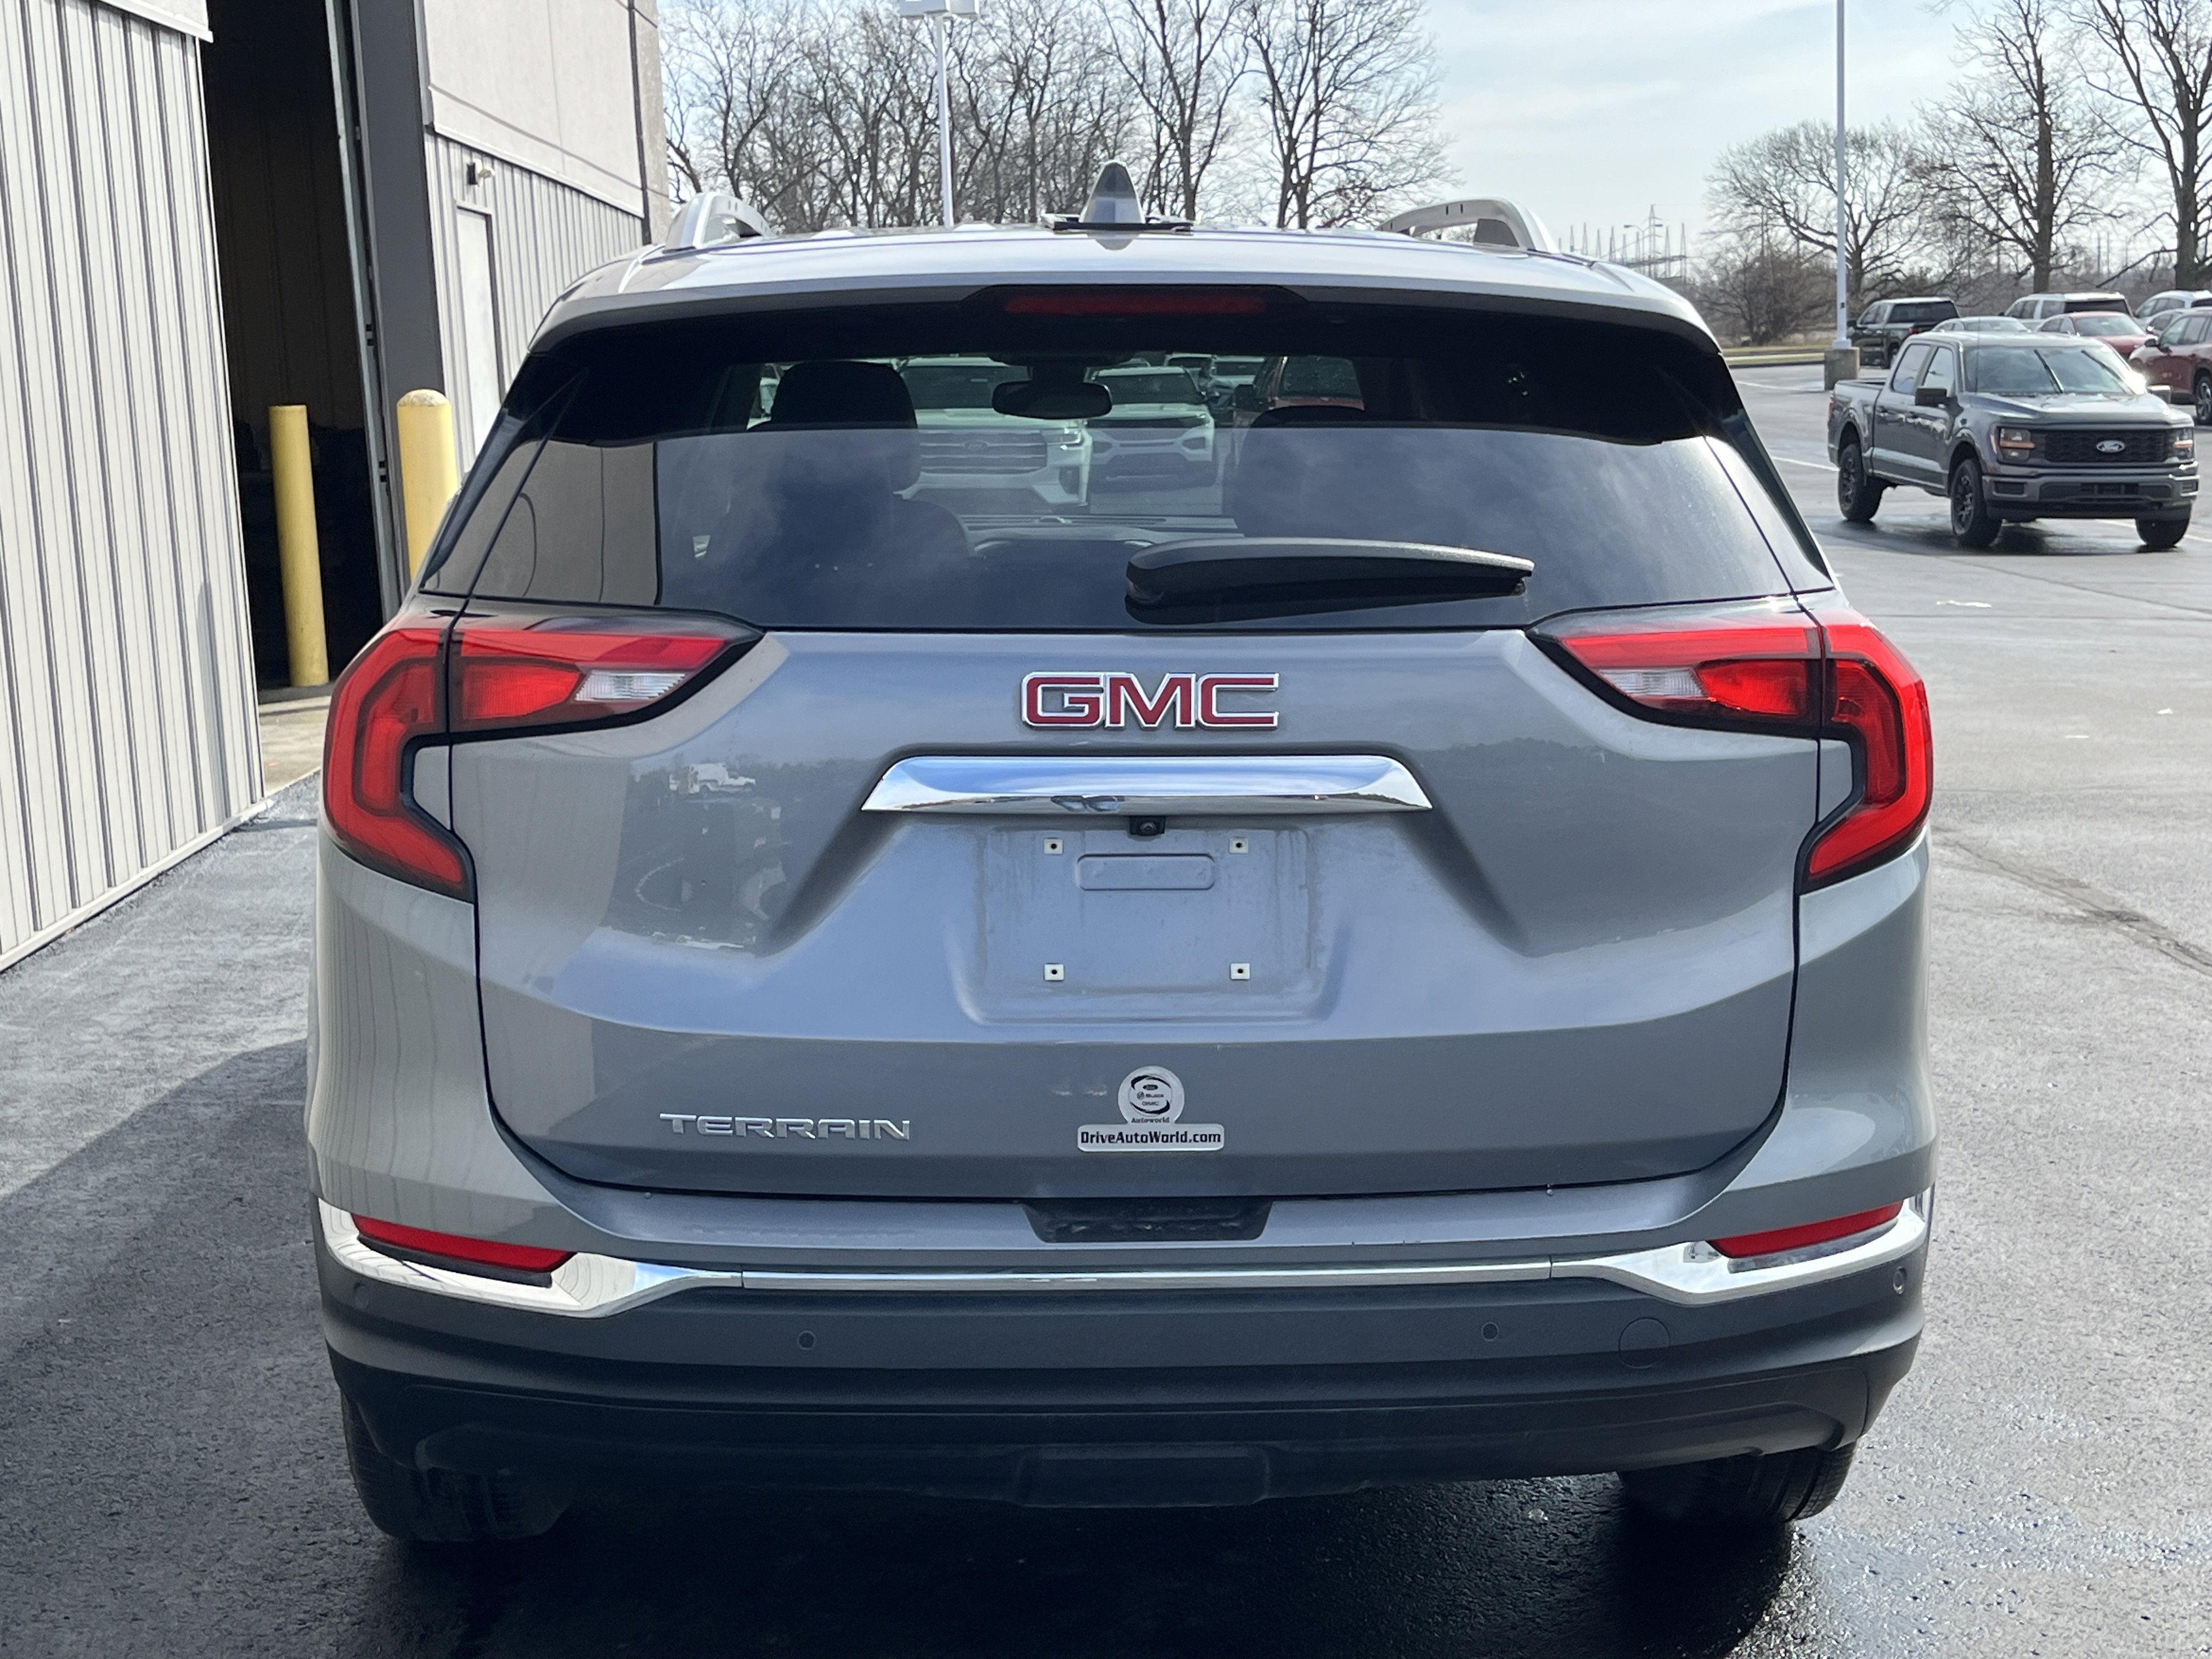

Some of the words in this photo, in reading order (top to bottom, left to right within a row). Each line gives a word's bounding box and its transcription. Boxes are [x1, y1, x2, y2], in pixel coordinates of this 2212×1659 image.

[1022, 672, 1279, 729] GMC
[659, 1113, 910, 1141] TERRAIN
[1081, 1131, 1221, 1144] DriveAutoWorld.com
